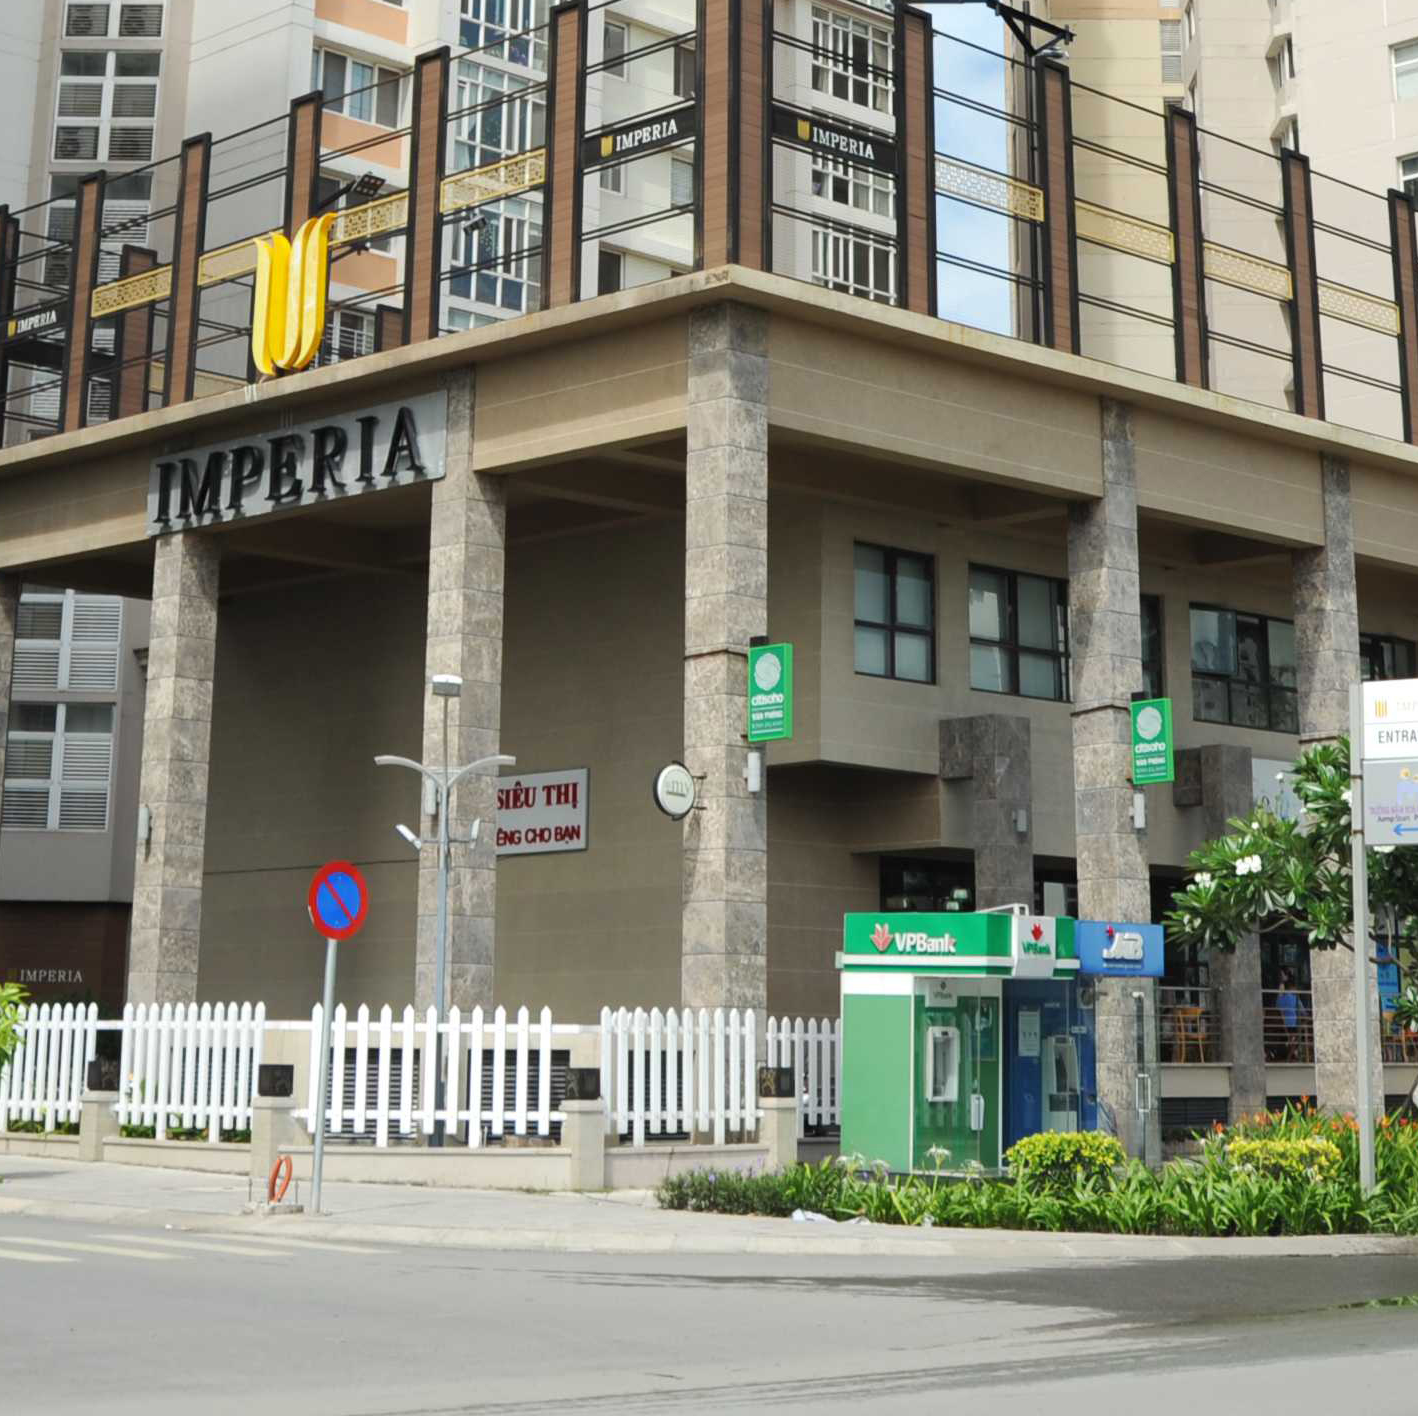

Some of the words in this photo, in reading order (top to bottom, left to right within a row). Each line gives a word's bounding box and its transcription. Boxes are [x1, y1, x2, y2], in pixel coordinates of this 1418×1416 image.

[615, 119, 678, 152] IMPERIA
[812, 126, 875, 160] IMPERIA
[17, 309, 57, 334] IMPERIA
[153, 406, 425, 523] IMPERIA
[497, 780, 537, 810] SIÊU
[542, 782, 579, 809] THỊ
[524, 827, 552, 844] CHO
[554, 824, 581, 845] BẠN
[895, 932, 957, 954] VPBank
[1022, 941, 1052, 956] VPBank
[20, 968, 83, 983] IMPERIA
